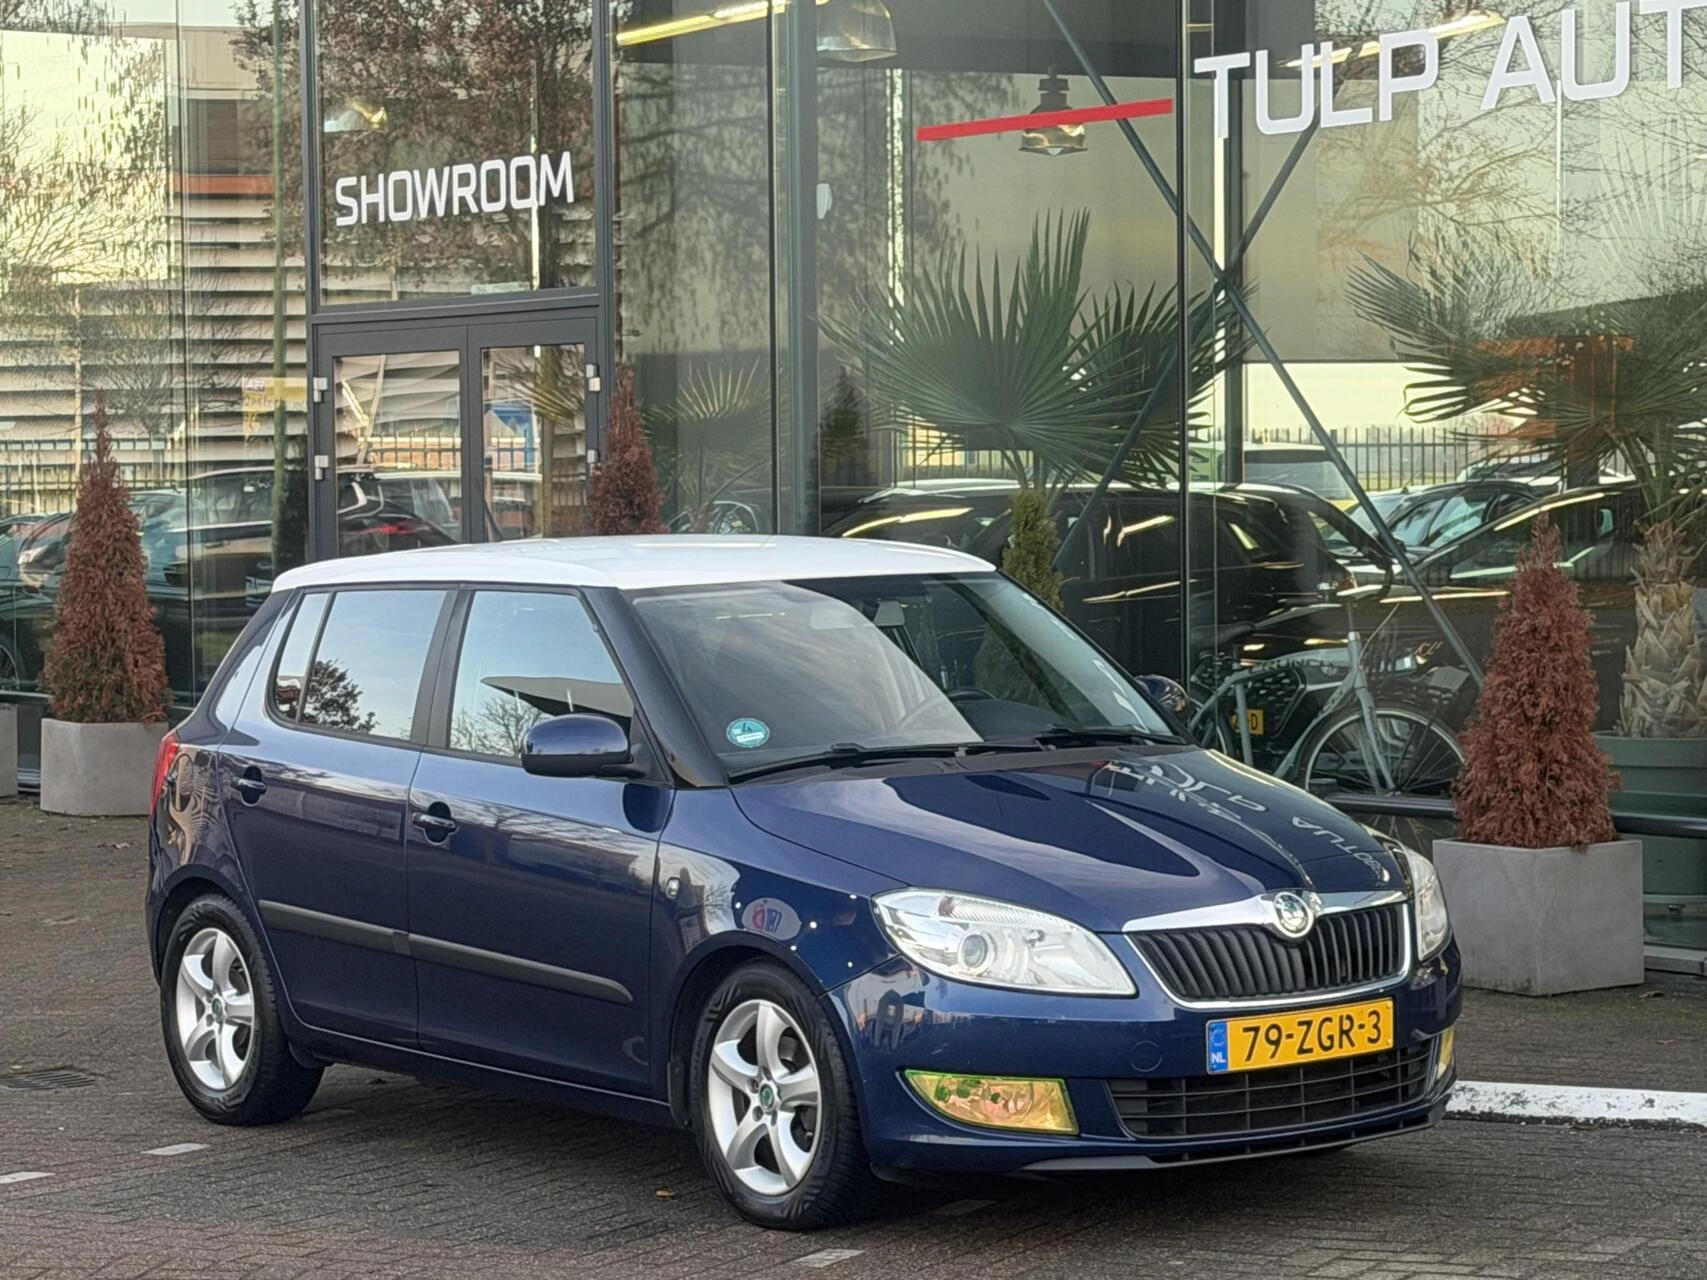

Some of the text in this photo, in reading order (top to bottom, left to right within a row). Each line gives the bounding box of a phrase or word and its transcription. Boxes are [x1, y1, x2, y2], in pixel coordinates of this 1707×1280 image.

[1194, 0, 1707, 139] TULP AUT
[336, 151, 574, 226] SHOWROOM
[1211, 1051, 1226, 1064] NL
[1242, 1009, 1382, 1062] 79-ZGR-3
